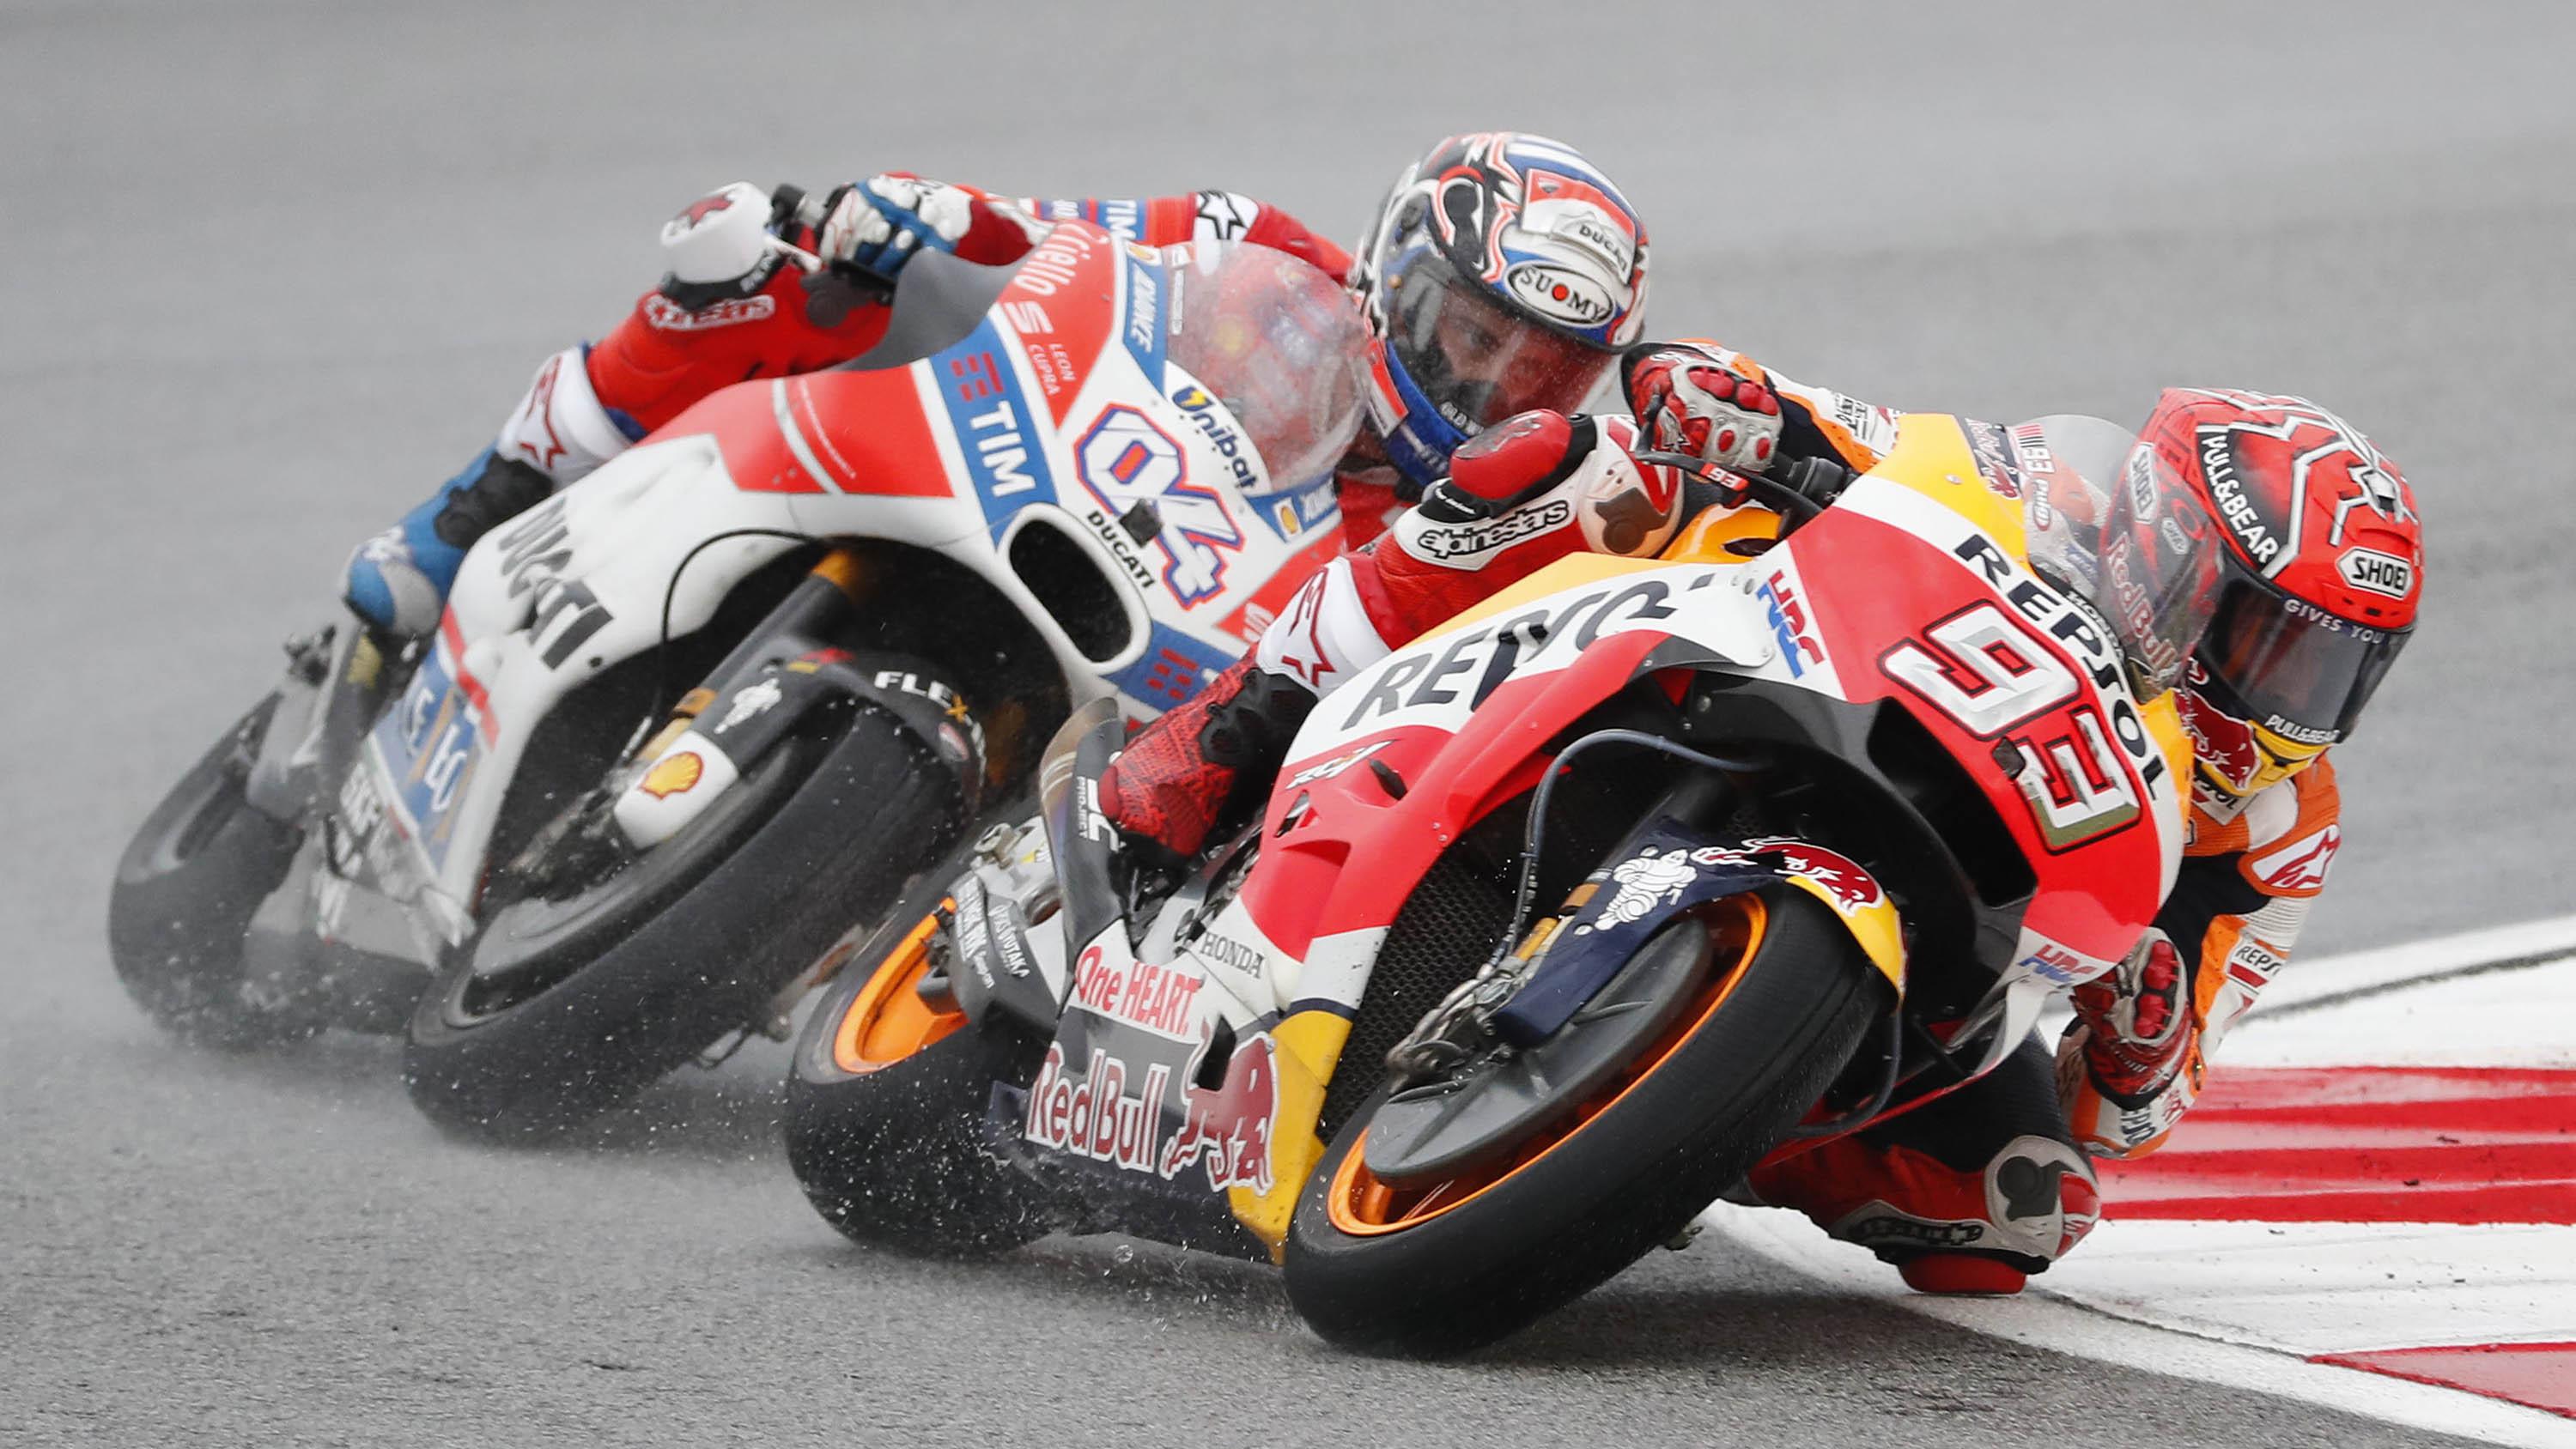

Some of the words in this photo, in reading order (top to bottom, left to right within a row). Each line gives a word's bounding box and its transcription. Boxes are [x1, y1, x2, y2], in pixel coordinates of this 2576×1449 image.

[1577, 224, 1629, 274] DUCATI
[1030, 343, 1060, 396] CUPRA
[1048, 343, 1076, 382] LEON
[969, 401, 1037, 498] TIM
[1171, 385, 1258, 489] Unibat
[1073, 403, 1246, 611] 04
[1417, 500, 1570, 560] alpinestars
[2200, 432, 2281, 566] PULL&BEAR
[1086, 509, 1156, 589] DUCATI
[2352, 555, 2407, 593] SHOEI
[2284, 597, 2343, 633] GIVES
[2349, 623, 2386, 646] YOU
[1955, 534, 2166, 800] REPSOL
[1076, 945, 1120, 1009] One
[1202, 931, 1265, 979] HONDA
